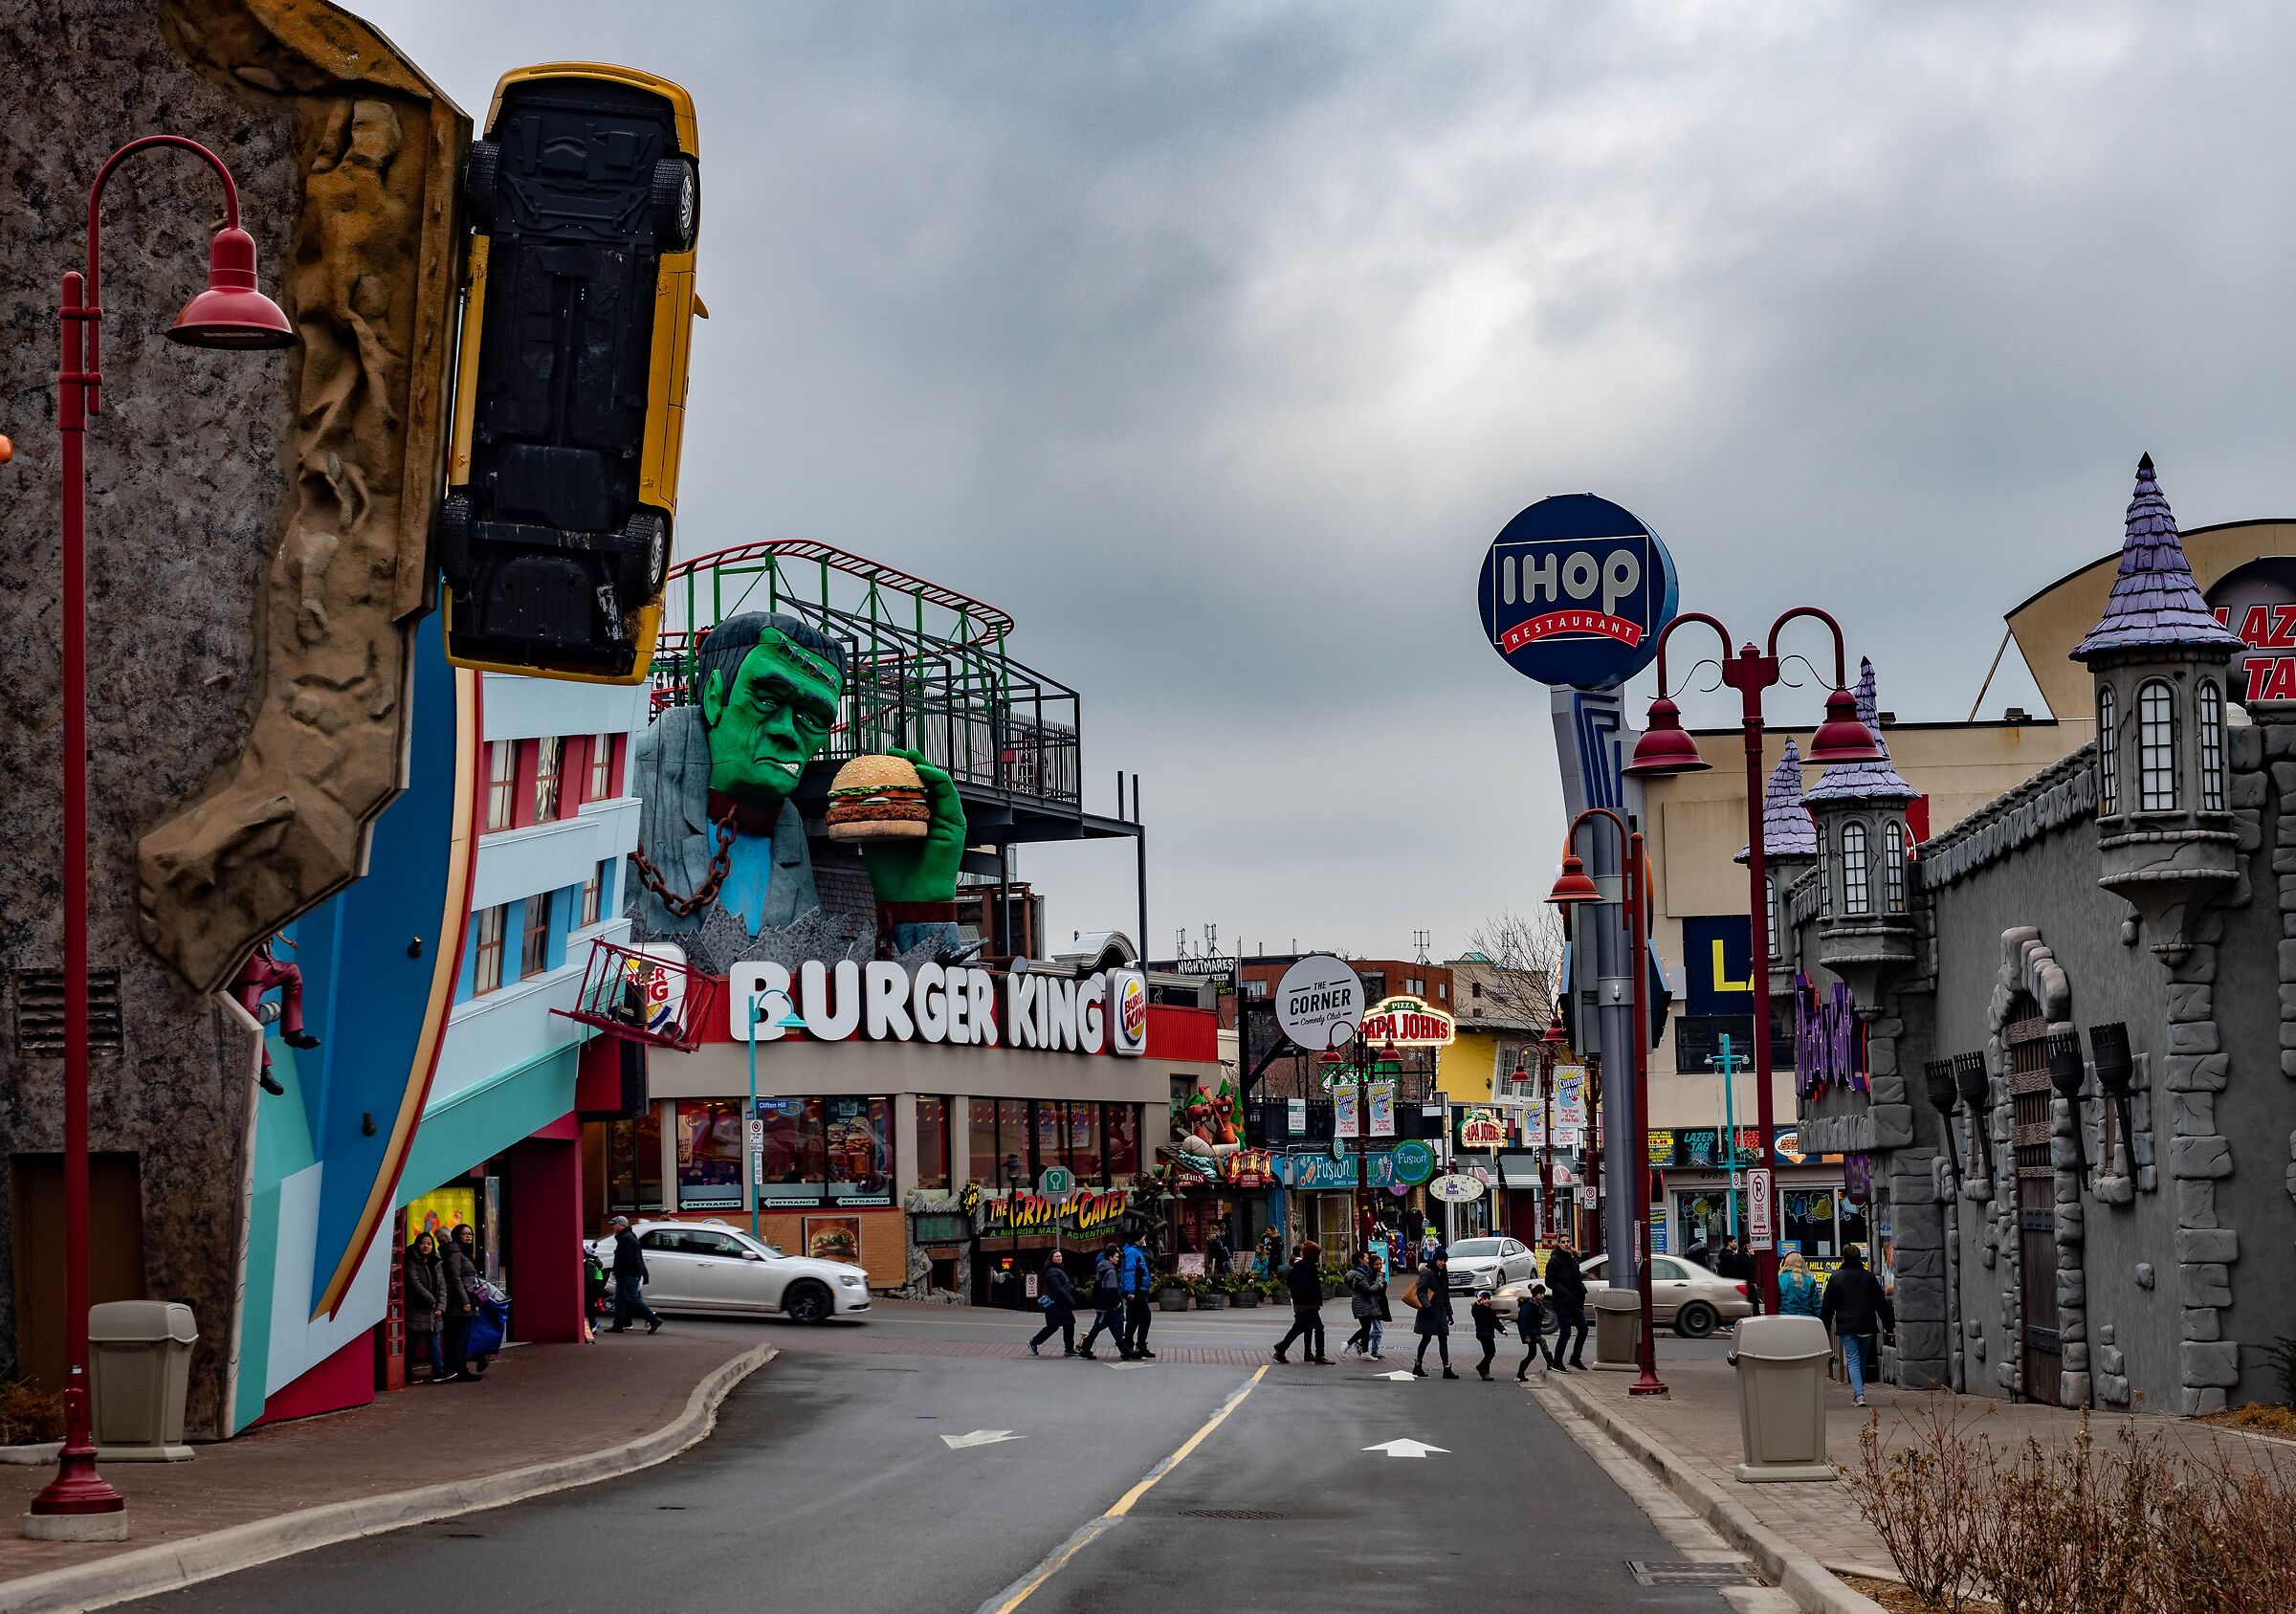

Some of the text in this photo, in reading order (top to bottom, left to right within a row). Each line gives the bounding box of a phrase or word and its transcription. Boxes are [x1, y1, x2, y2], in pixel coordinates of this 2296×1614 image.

[1510, 616, 1633, 644] RESTAURANT
[2242, 657, 2296, 700] TA
[1178, 959, 1234, 975] NIGHTMARES
[1314, 981, 1327, 990] THE
[730, 961, 999, 1046] BURGER
[1007, 972, 1103, 1053] KING
[1290, 988, 1351, 1015] CORNER
[1300, 1010, 1341, 1026] Comedy Club
[1401, 1014, 1447, 1039] JOHN'S
[1558, 1077, 1582, 1089] Clifton
[1371, 1092, 1391, 1104] Clifton
[1565, 1087, 1578, 1098] Hill
[1336, 1093, 1356, 1105] Clifton
[1342, 1101, 1354, 1112] Hill
[1378, 1100, 1389, 1111] Hill
[1525, 1108, 1543, 1117] Clifton
[1532, 1116, 1541, 1124] Hill
[1685, 1133, 1715, 1143] LAZER
[1691, 1141, 1710, 1152] TAG
[1398, 1153, 1426, 1164] Fusion
[990, 1199, 1008, 1222] THE
[1078, 1190, 1128, 1229] CAVES
[1755, 1204, 1764, 1212] FIRE
[1755, 1213, 1765, 1223] LANE
[1067, 1227, 1115, 1240] ADVENTURE
[1809, 1262, 1824, 1271] HILL
